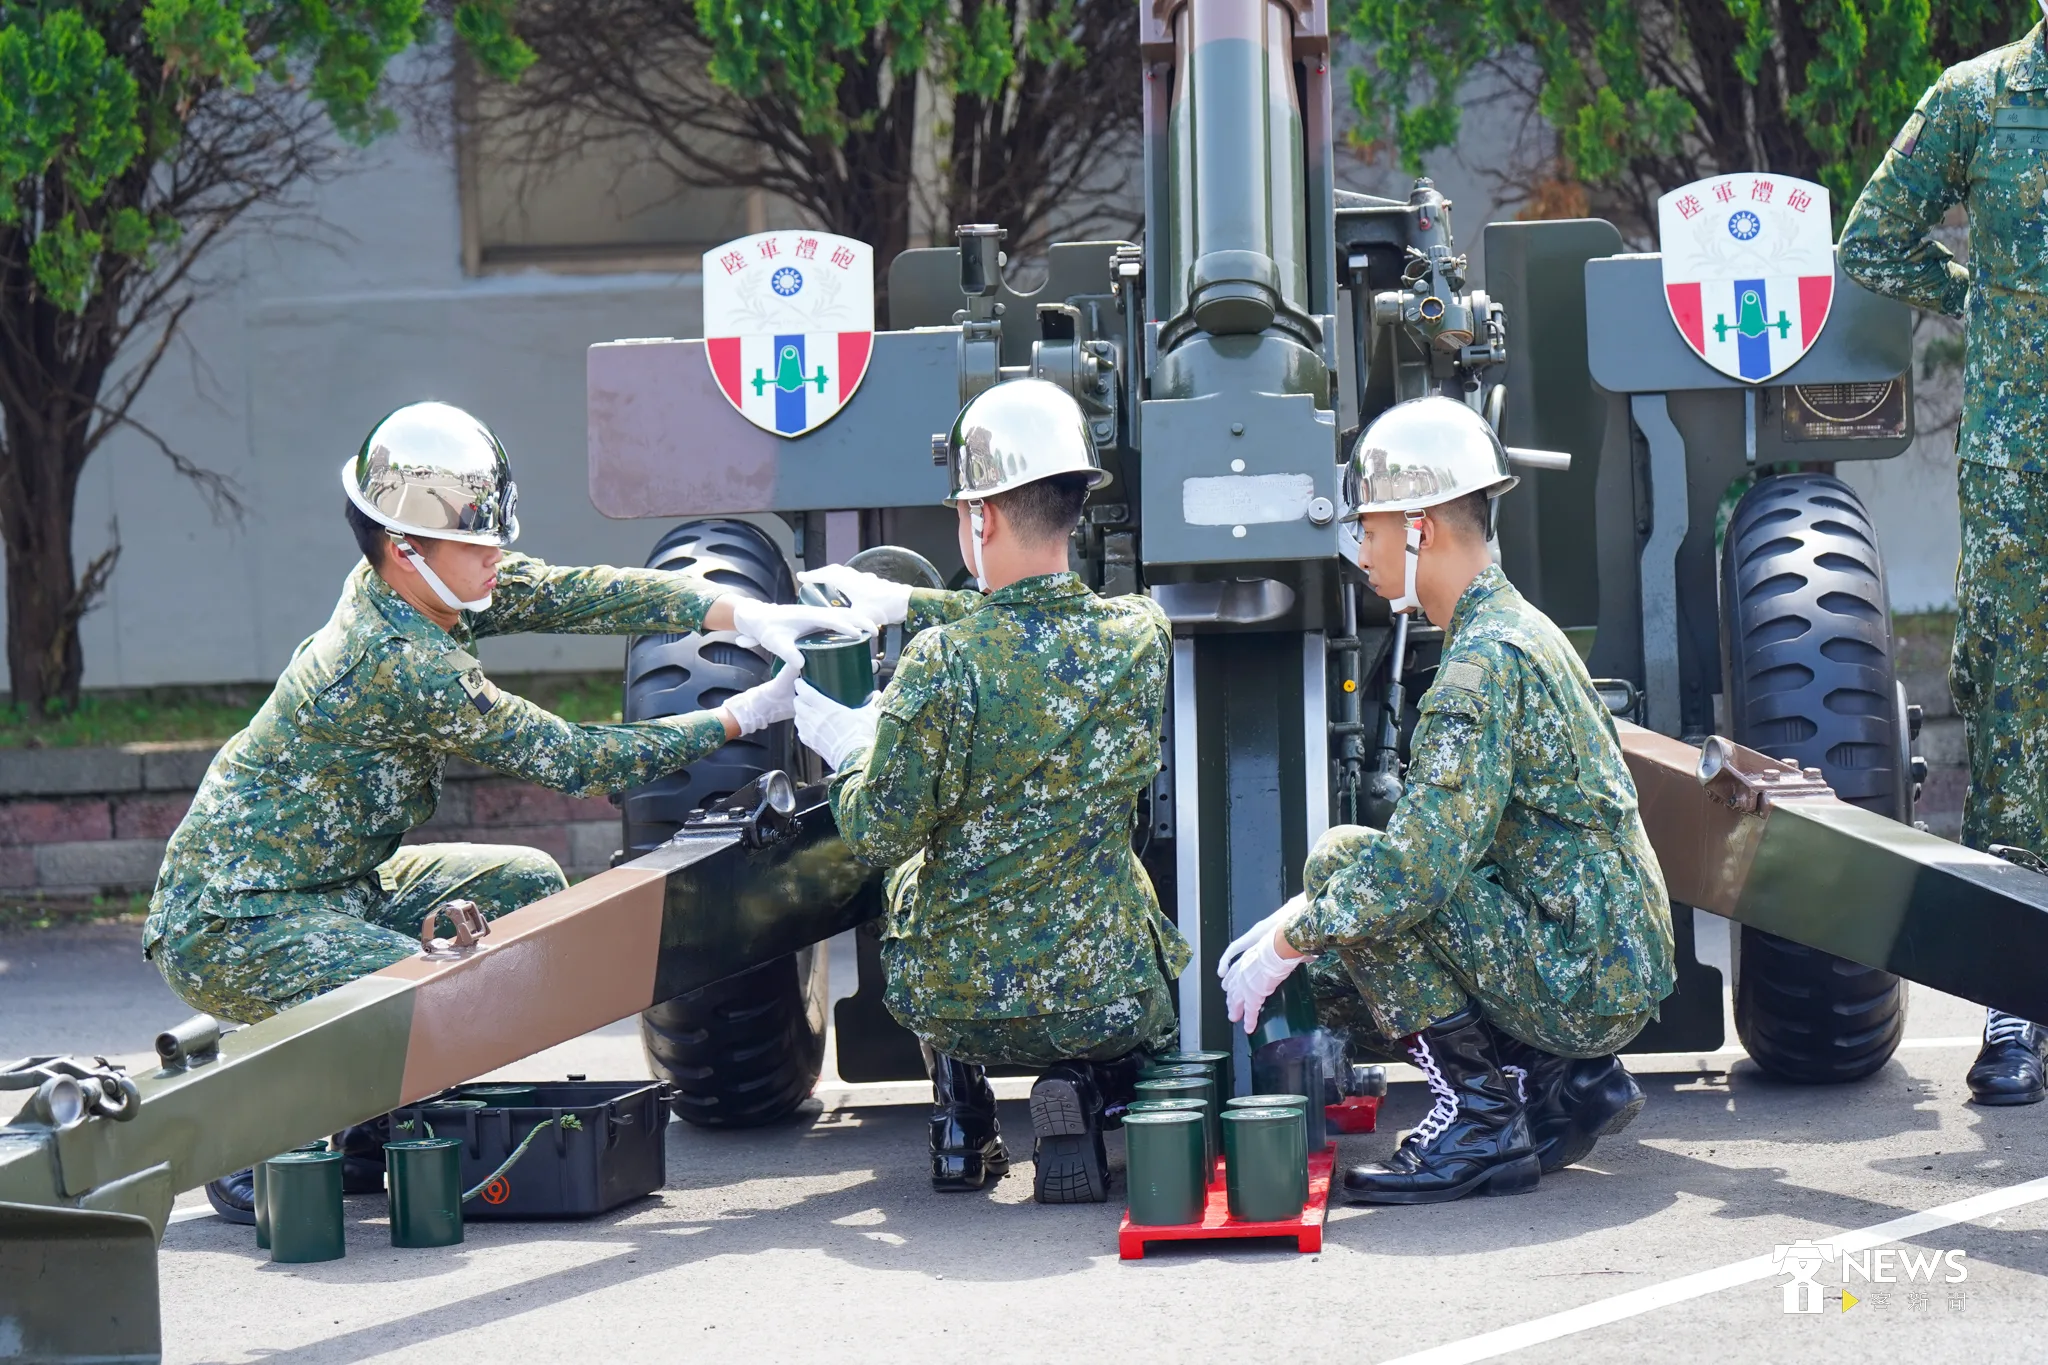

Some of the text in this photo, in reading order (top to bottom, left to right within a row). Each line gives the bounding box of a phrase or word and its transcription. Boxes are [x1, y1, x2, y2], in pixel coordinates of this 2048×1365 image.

[1675, 178, 1812, 220] 陸軍禮砲
[720, 236, 855, 276] 陸軍禮砲
